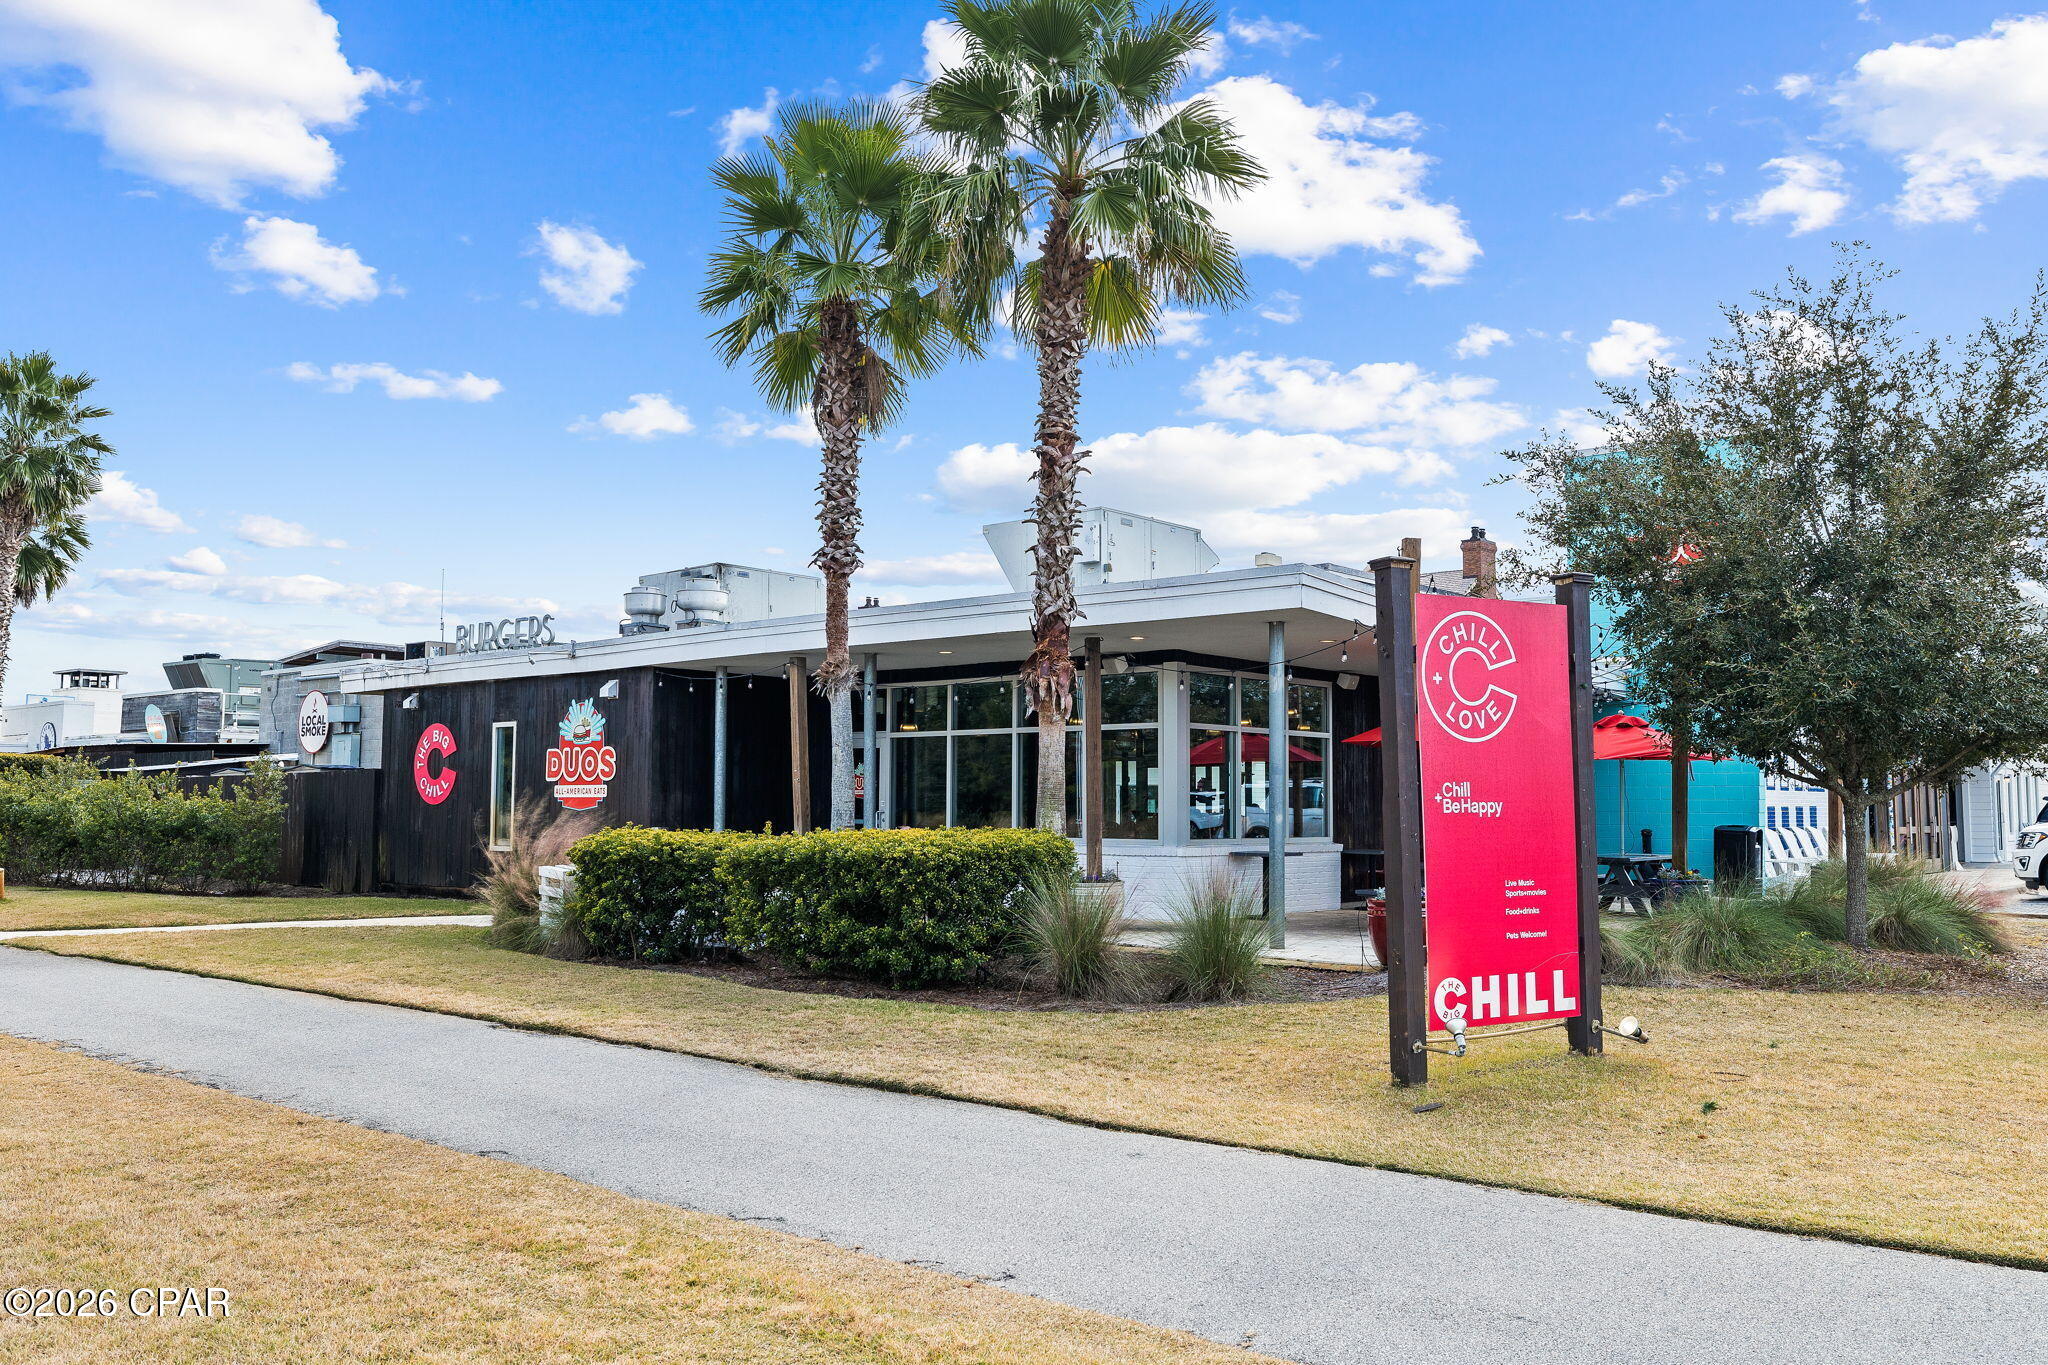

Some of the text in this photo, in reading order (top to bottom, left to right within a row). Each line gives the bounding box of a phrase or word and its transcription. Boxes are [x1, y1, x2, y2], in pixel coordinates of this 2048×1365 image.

[456, 614, 556, 653] BURGERS
[1439, 622, 1501, 660] CHILL
[301, 715, 326, 727] LOCAL
[1445, 700, 1502, 730] LOVE
[301, 725, 326, 737] SMOKE
[416, 729, 450, 770] THE BIG
[546, 746, 617, 782] DUOS
[420, 777, 450, 798] CHILL
[555, 787, 606, 795] ALL-AMERICAN EATS
[1442, 781, 1471, 798] Chill
[1443, 798, 1503, 818] BeHappy
[1505, 889, 1547, 898] Sports+movies
[1505, 907, 1540, 915] Food+drinks
[1520, 930, 1548, 938] Welcome!
[1434, 970, 1577, 1022] CHILL
[1442, 982, 1461, 993] THE
[1442, 1009, 1461, 1019] BIG
